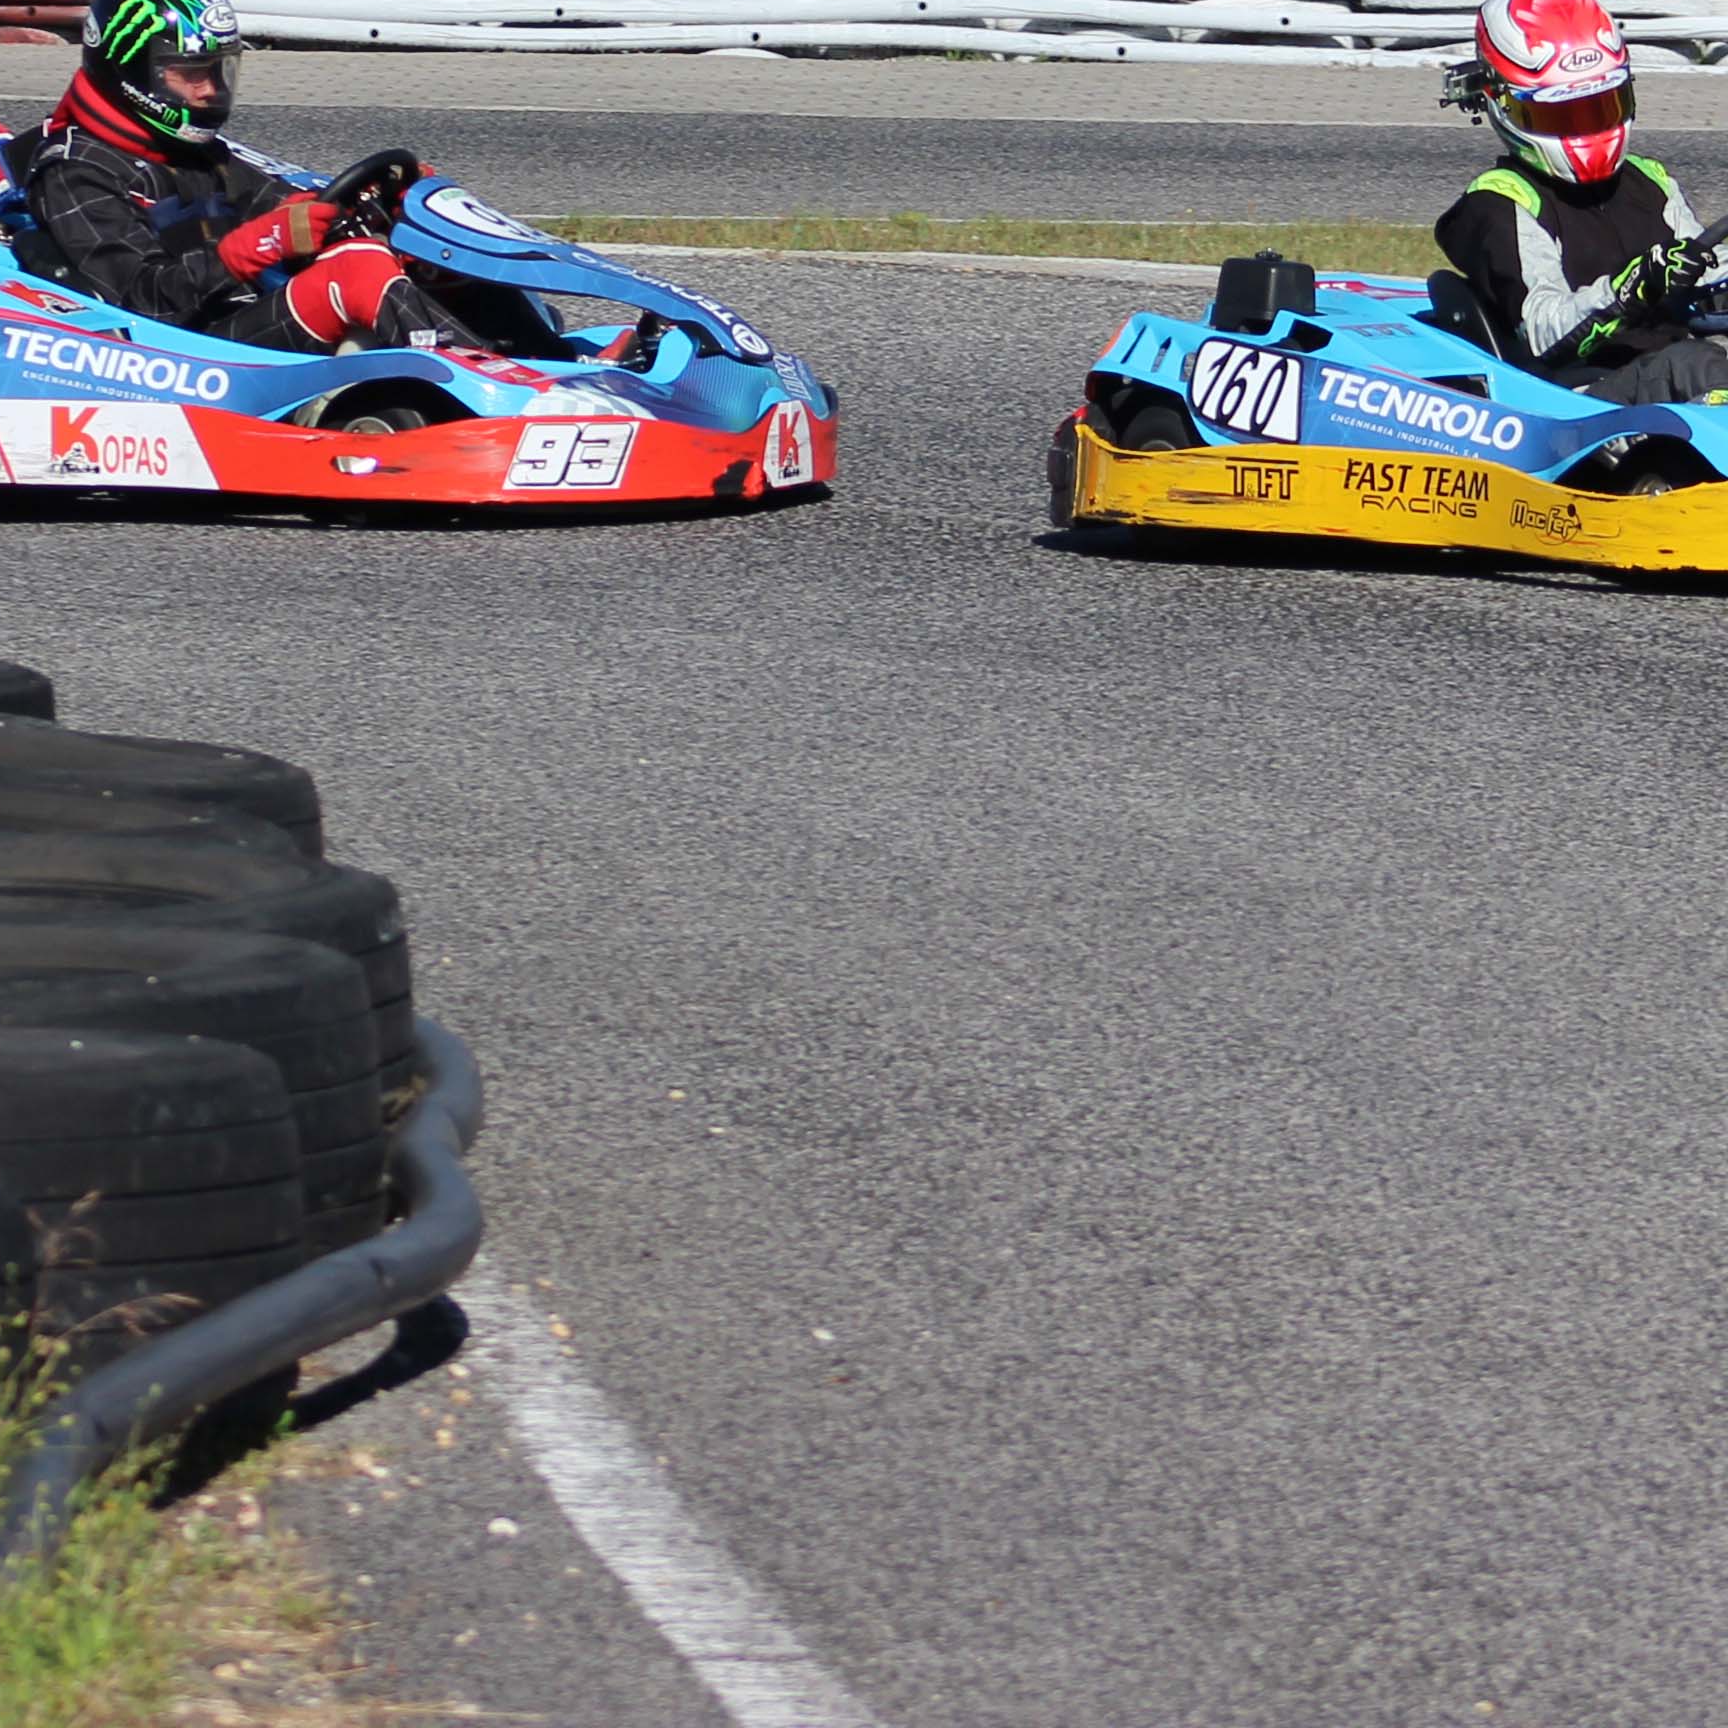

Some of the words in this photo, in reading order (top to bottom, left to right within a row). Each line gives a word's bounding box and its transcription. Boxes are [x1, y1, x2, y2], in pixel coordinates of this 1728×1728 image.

[3, 326, 230, 401] TECNIROLO
[22, 370, 92, 392] ENGENHARIA
[1196, 345, 1290, 437] 160
[50, 406, 168, 476] KOPAS
[1318, 367, 1523, 450] TECNIROLO
[1330, 413, 1393, 437] ENGENHARIA
[508, 421, 634, 486] 93
[1343, 458, 1413, 493] FAST
[1423, 465, 1490, 501] TEAM
[1361, 494, 1478, 518] RACING
